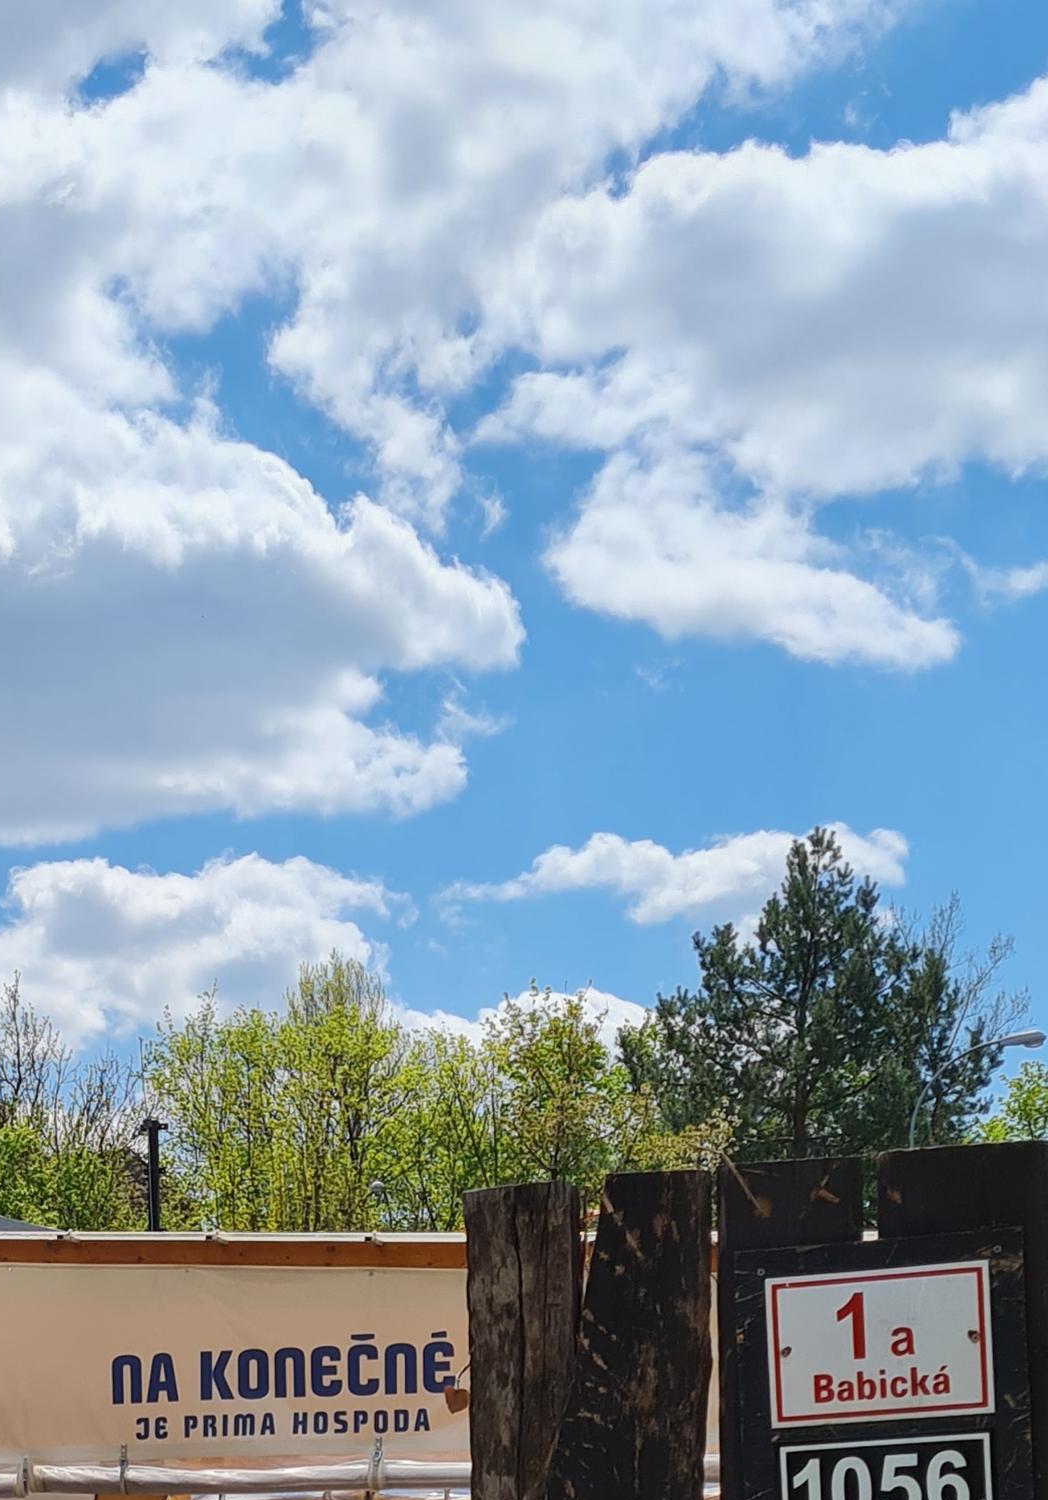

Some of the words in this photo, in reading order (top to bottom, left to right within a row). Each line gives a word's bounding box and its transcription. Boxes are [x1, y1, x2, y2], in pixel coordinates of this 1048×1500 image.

[836, 1291, 866, 1360] 1
[890, 1325, 916, 1357] a
[112, 1352, 179, 1405] NA
[199, 1331, 456, 1402] KONEČNÉ
[813, 1365, 950, 1404] Babická
[136, 1416, 169, 1440] JE
[184, 1412, 276, 1438] PRIMA
[292, 1407, 431, 1435] HOSPODA
